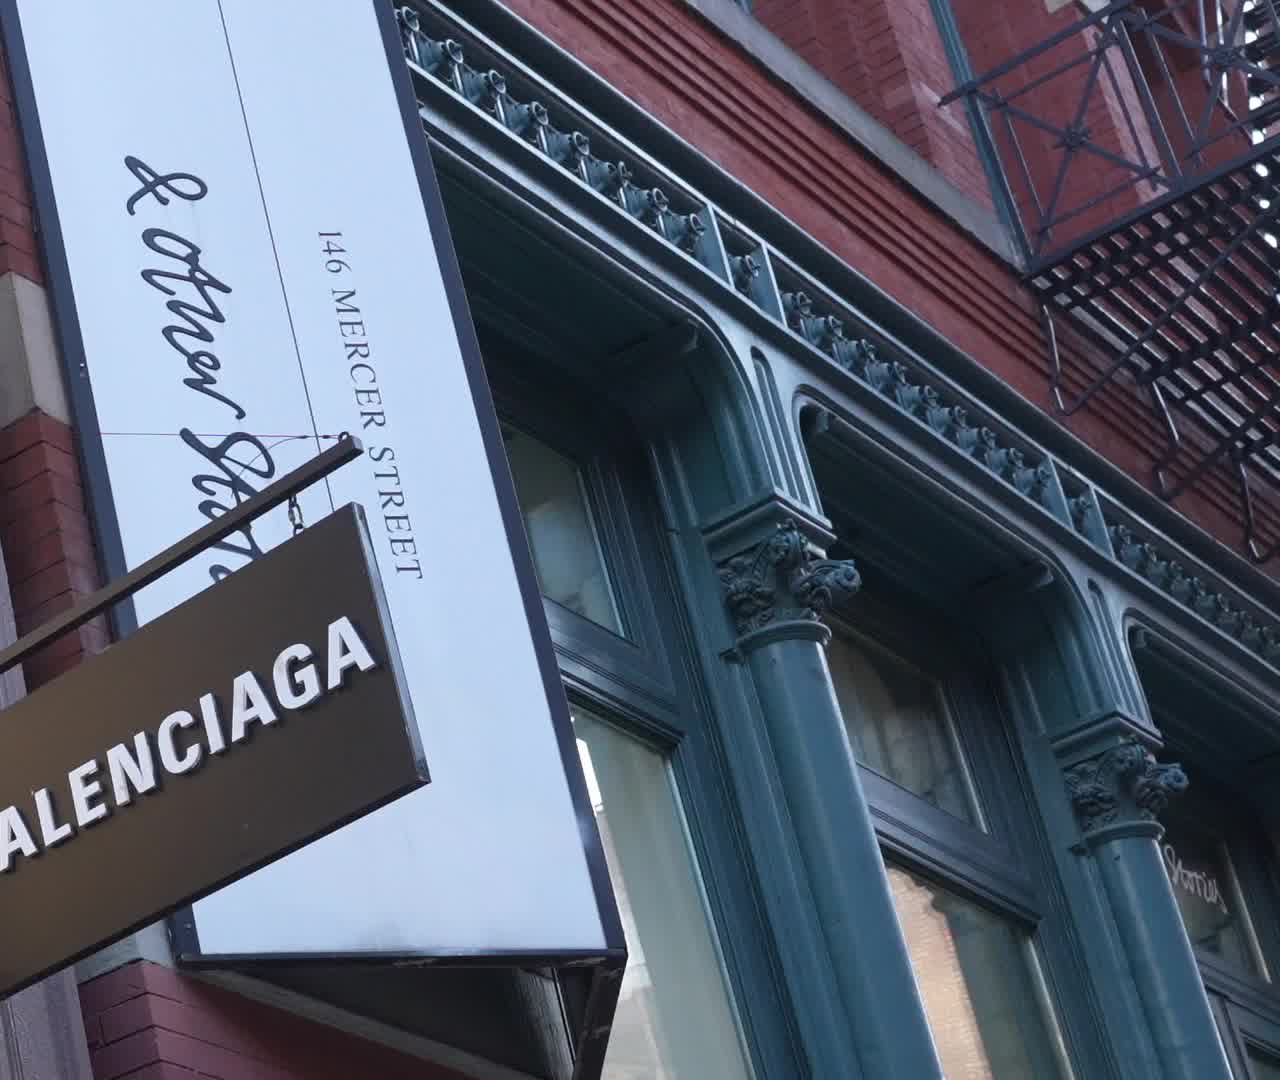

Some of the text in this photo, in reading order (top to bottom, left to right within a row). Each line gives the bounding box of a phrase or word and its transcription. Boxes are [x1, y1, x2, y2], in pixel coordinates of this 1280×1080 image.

[124, 155, 208, 216] &
[318, 231, 423, 579] 146 MERCER STREET
